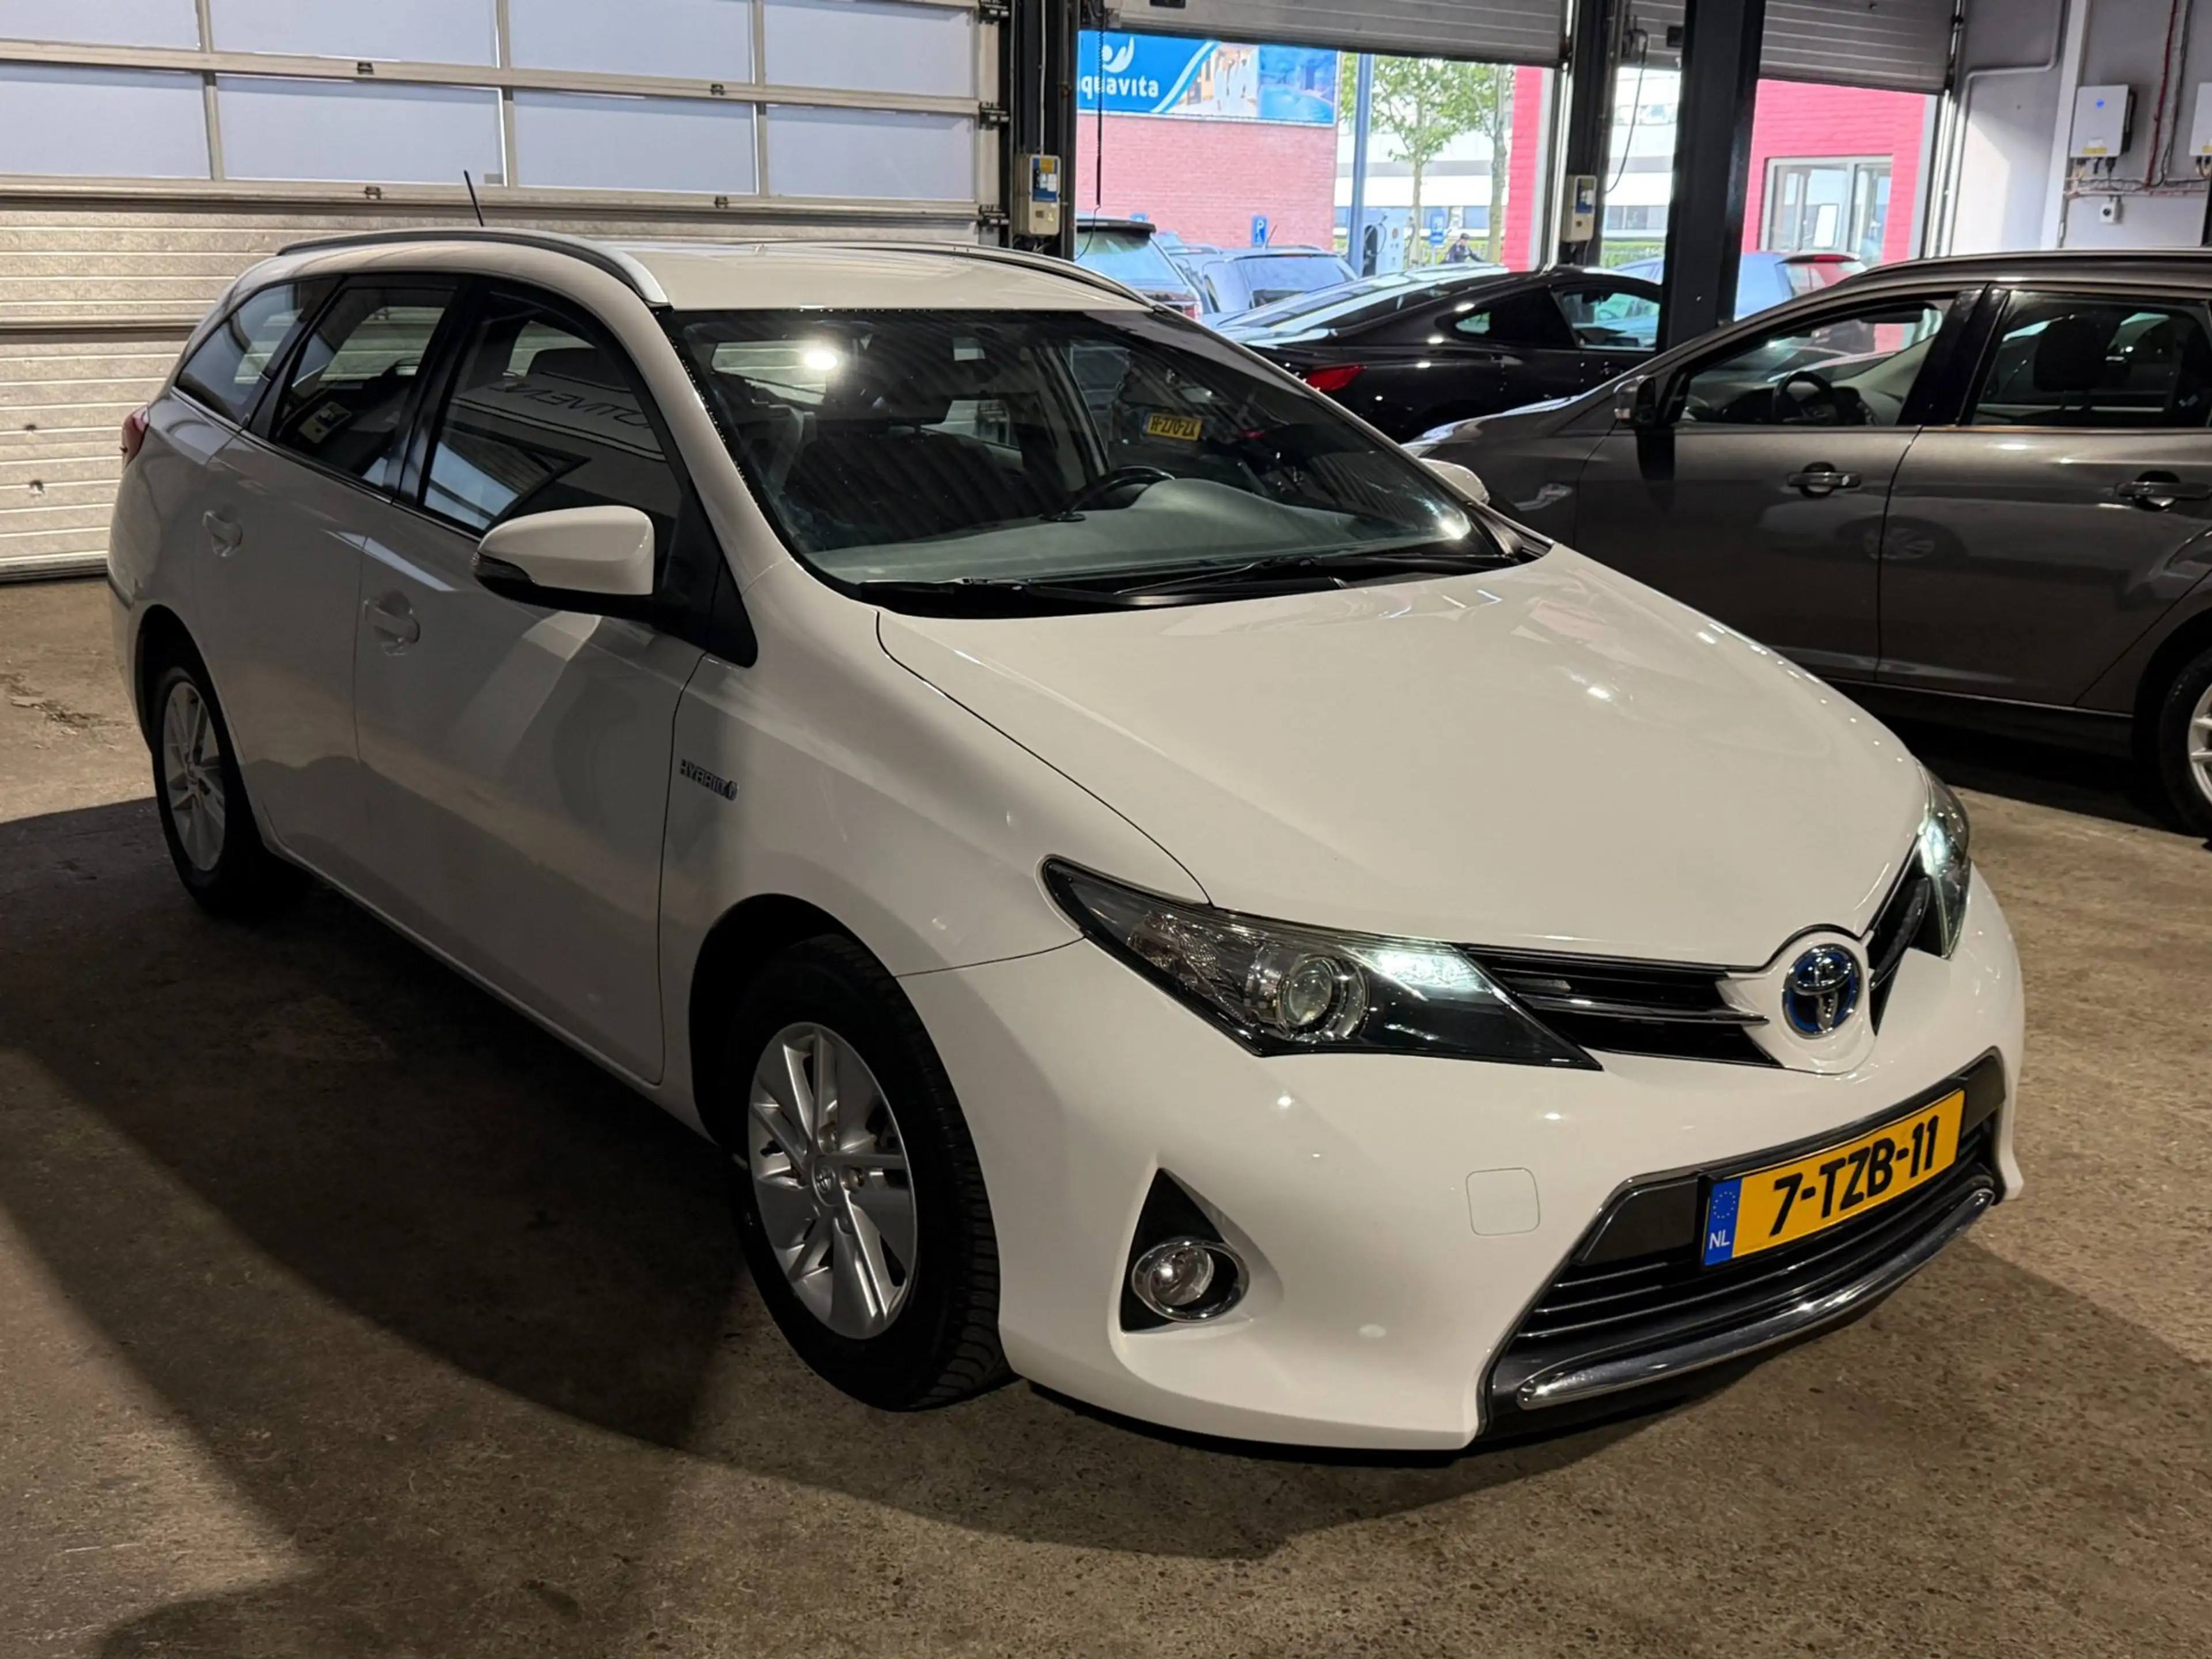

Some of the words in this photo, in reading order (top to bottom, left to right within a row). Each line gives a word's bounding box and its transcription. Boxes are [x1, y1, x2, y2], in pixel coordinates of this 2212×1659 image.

[1081, 75, 1158, 100] quavita
[1257, 219, 1264, 233] P
[680, 759, 726, 797] HYBRID
[1770, 1115, 1939, 1237] 7-TZB-11
[1709, 1229, 1730, 1250] NL
